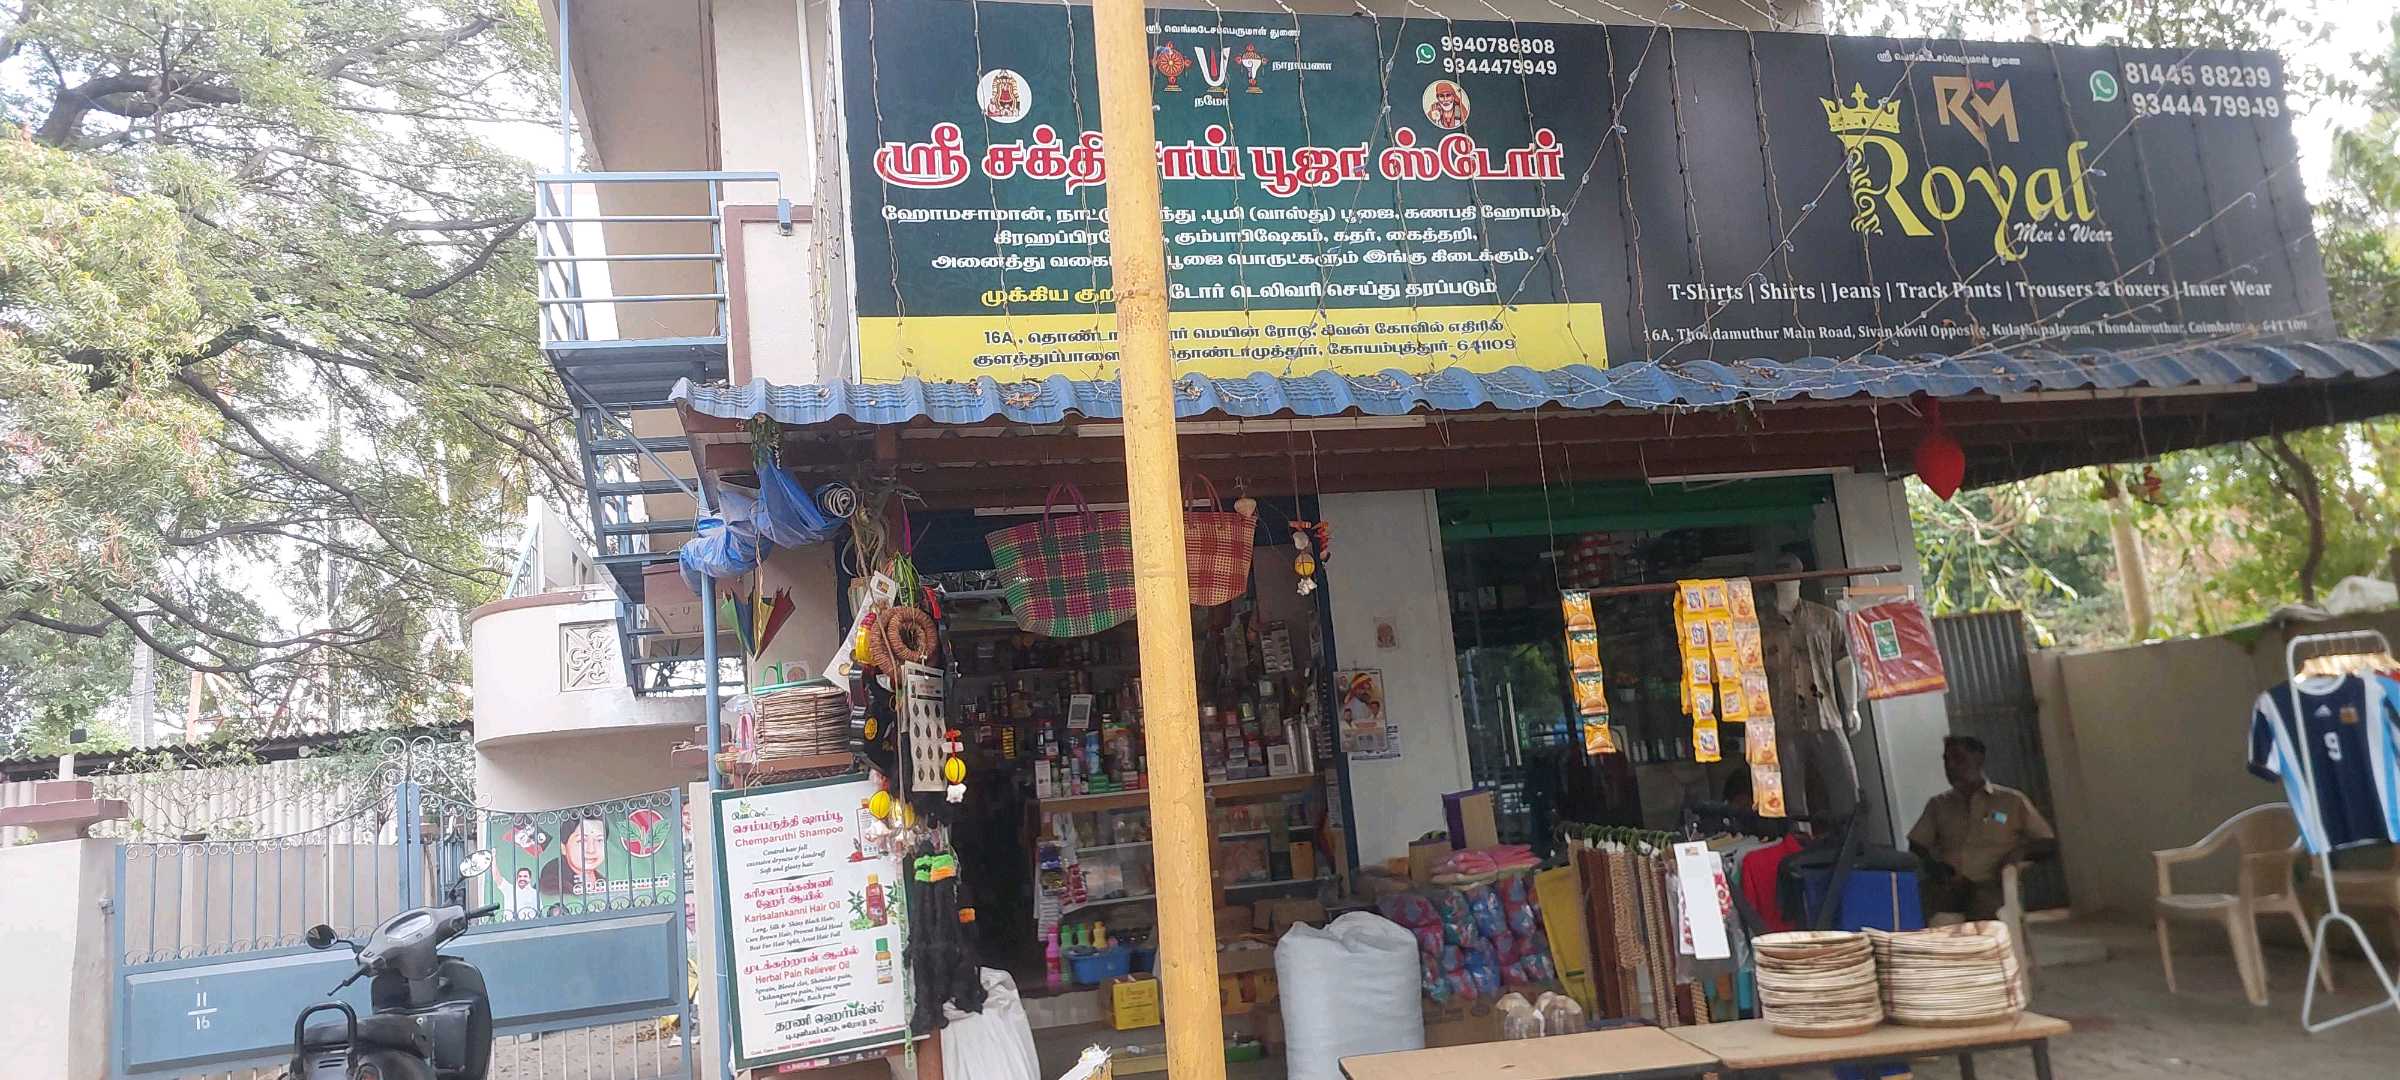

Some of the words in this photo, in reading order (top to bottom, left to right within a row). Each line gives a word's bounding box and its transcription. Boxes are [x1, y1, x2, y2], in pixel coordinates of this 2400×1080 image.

[1440, 36, 1555, 55] 9940786808
[1443, 58, 1557, 75] 9344479949
[2125, 61, 2196, 86] 81445
[2131, 92, 2207, 117] 93444
[2209, 95, 2280, 118] 79949
[873, 121, 970, 189] ஸ்ரீ
[1247, 142, 1369, 198] பூஜா
[1379, 126, 1565, 181] ஸ்டோர்
[1836, 133, 2097, 263] Royal
[1250, 206, 1336, 224] (வாஸ்து)
[1404, 206, 1477, 222] கணபதி
[2013, 221, 2066, 243] Men's
[2069, 223, 2113, 243] Wear
[931, 253, 1045, 272] அனைத்து
[981, 286, 1069, 308] முக்கிய
[1327, 280, 1401, 300] செய்து
[1668, 282, 1743, 301] T-Shirts
[1760, 282, 1816, 301] Shirts
[1830, 282, 1881, 300] Jeans
[1896, 282, 1949, 299] Track
[2014, 281, 2093, 298] Trousers
[2230, 281, 2273, 297] Wear
[1783, 326, 1816, 340] Main
[1930, 324, 1990, 341] Opposie,
[2322, 731, 2344, 762] 9
[799, 825, 844, 839] Shampoo
[809, 902, 826, 913] Hair
[828, 900, 841, 910] Oil
[755, 972, 782, 985] Herbal
[784, 969, 802, 980] Pain
[838, 960, 850, 970] Oil
